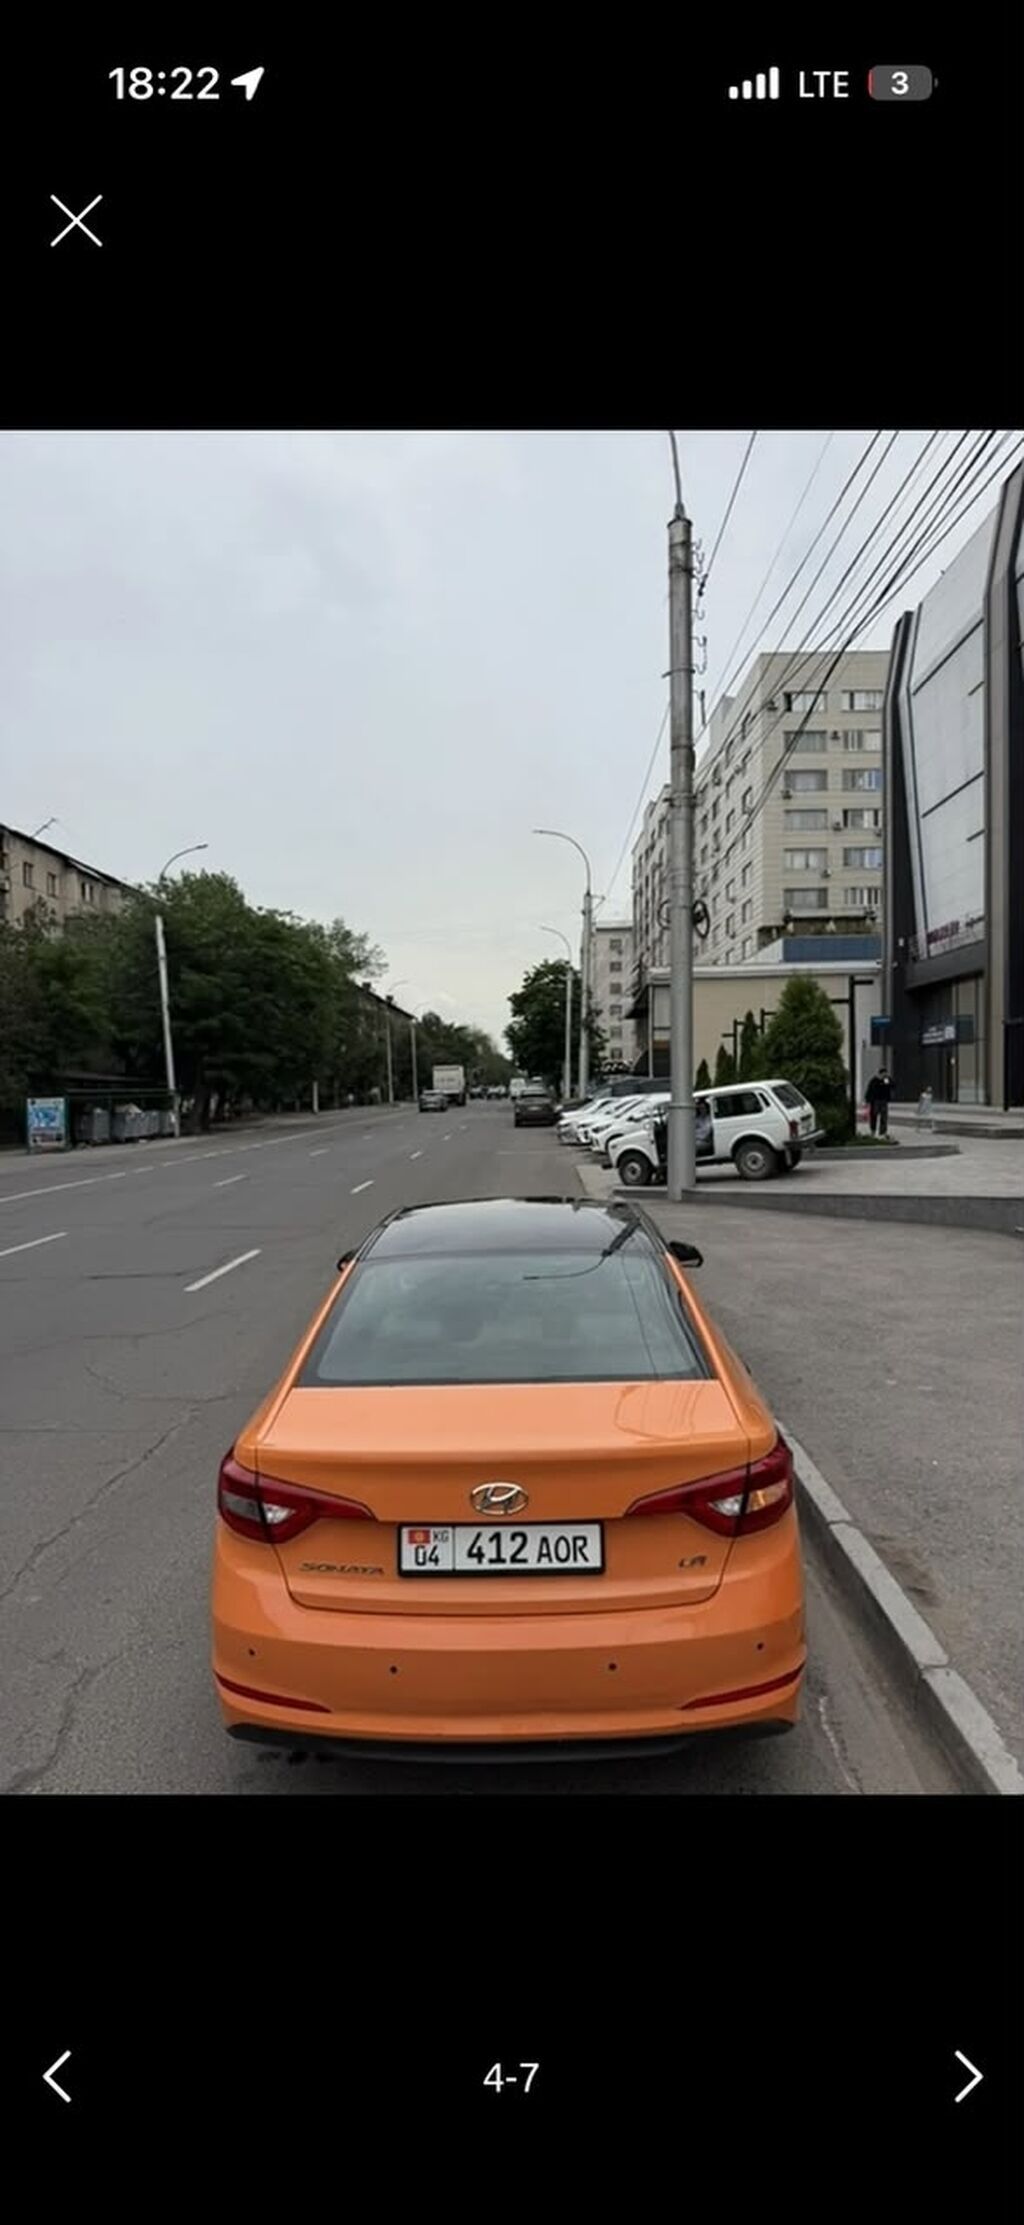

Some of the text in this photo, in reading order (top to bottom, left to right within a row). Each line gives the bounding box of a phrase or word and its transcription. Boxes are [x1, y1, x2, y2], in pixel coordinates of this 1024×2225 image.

[433, 1530, 449, 1543] KG
[414, 1545, 440, 1567] 04
[466, 1531, 590, 1565] 412 AOR
